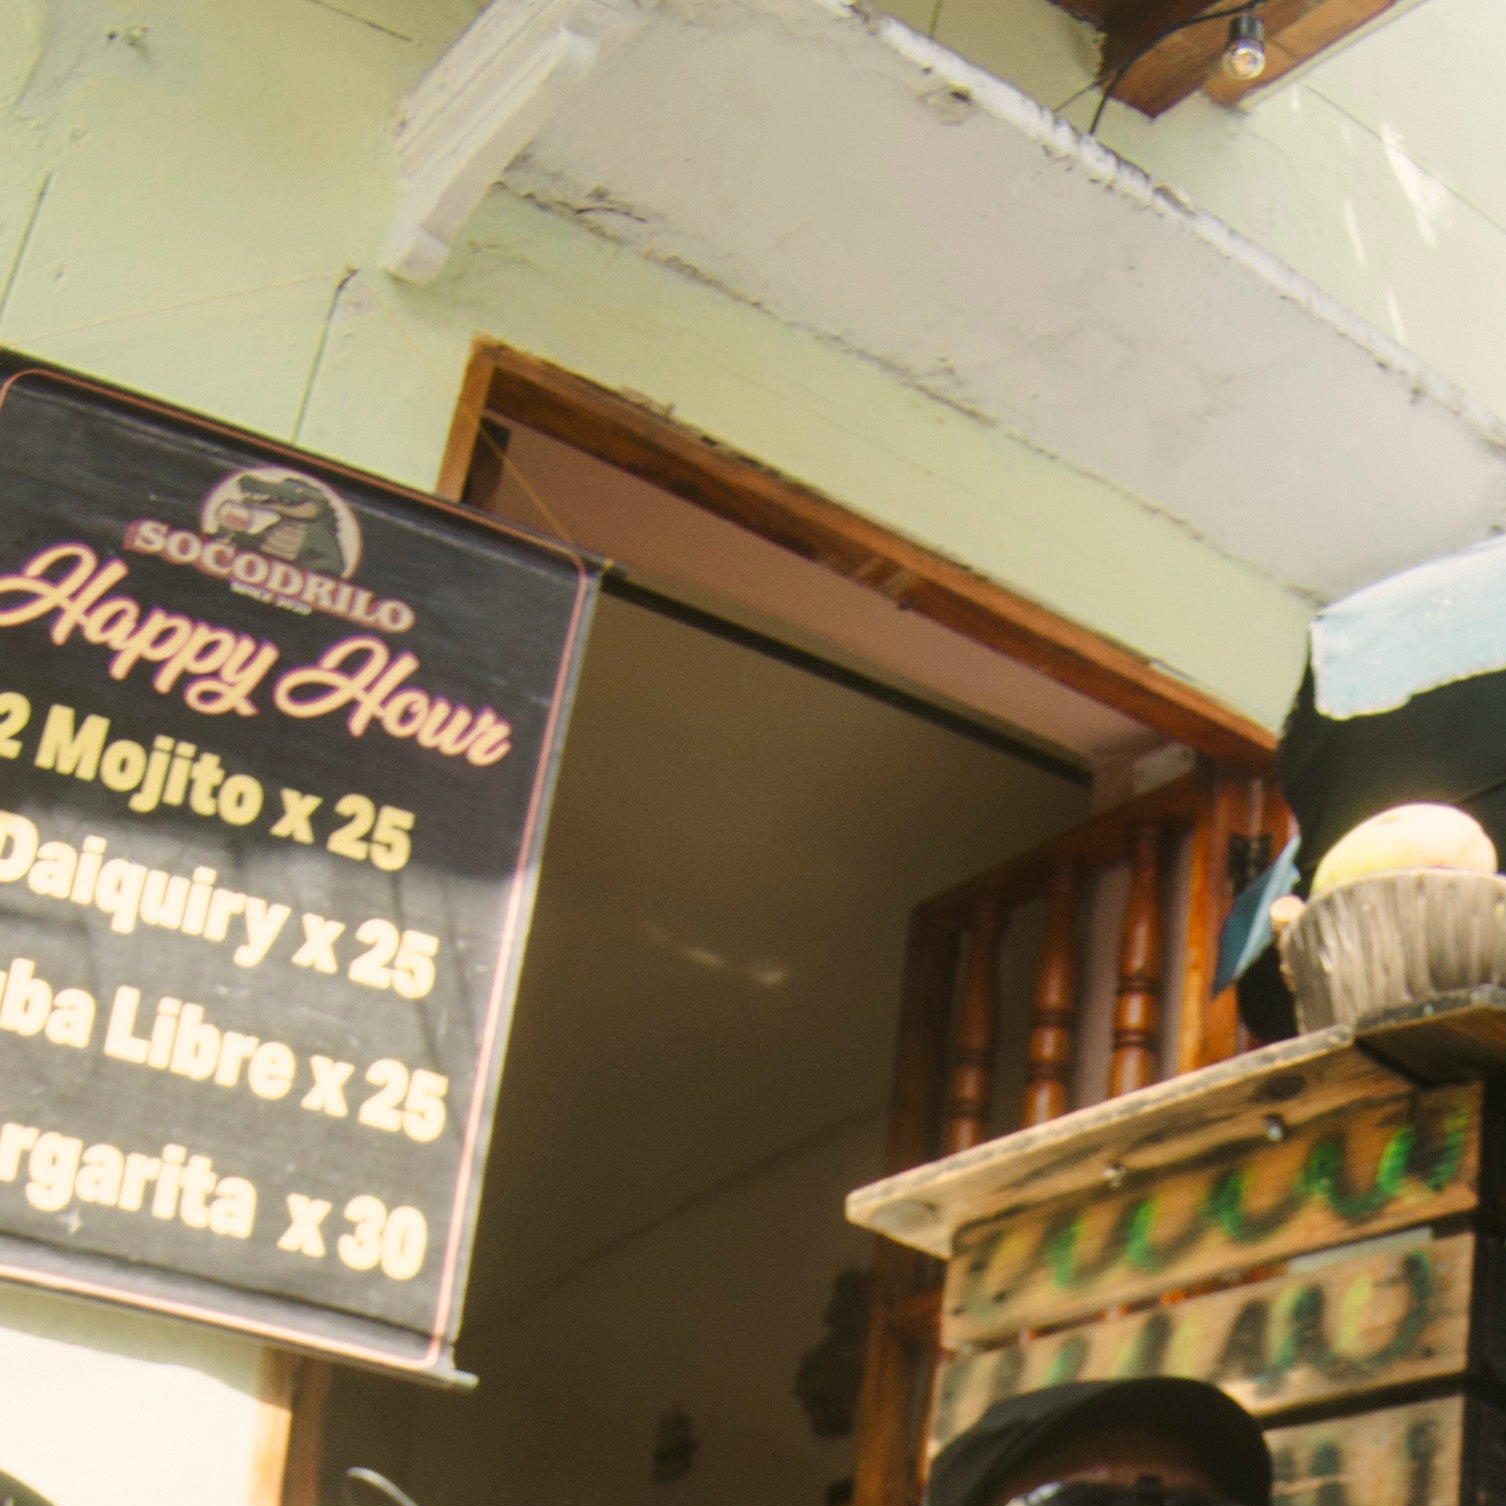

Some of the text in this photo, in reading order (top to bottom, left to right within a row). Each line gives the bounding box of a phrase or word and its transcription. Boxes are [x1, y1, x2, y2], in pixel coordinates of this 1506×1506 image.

[0, 544, 511, 766] Happy Hour
[129, 520, 413, 632] SOCODRILO
[0, 691, 416, 871] 2 Mojito x 25
[0, 810, 439, 999] Daiquiry x 25
[104, 985, 296, 1100] Libre
[301, 1054, 354, 1118] x
[358, 1058, 448, 1142] 25
[278, 1193, 333, 1258] x
[338, 1195, 428, 1281] 30
